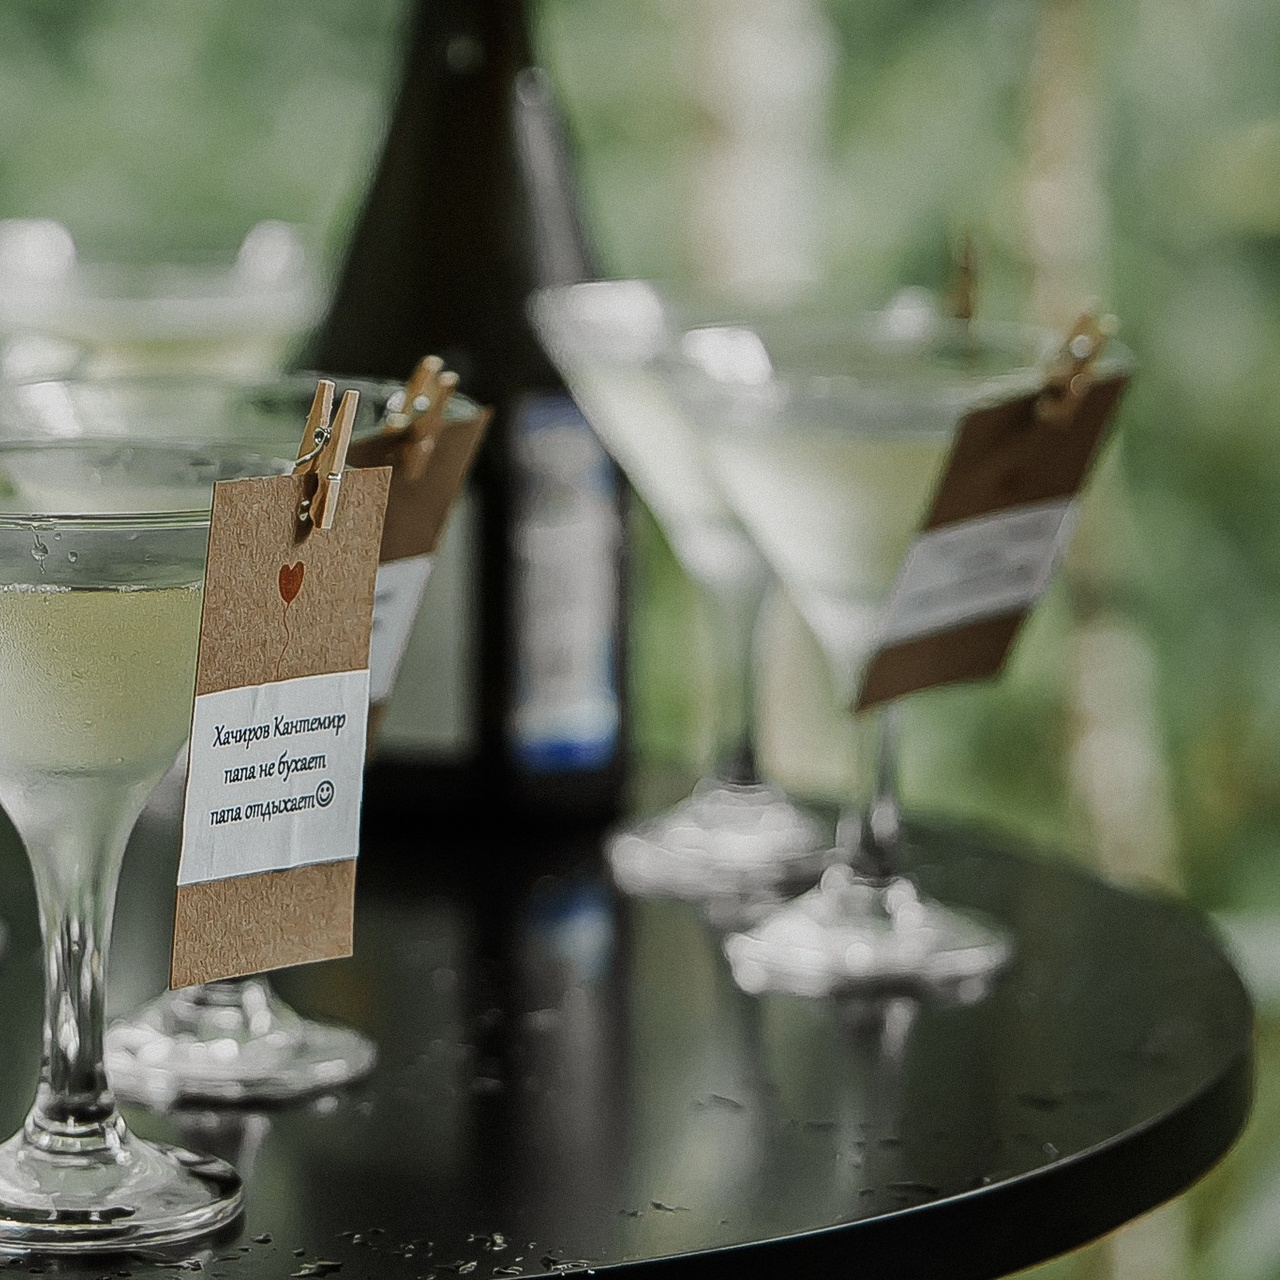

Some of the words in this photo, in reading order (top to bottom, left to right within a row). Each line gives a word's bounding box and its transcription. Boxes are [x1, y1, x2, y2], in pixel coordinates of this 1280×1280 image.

[212, 724, 271, 749] Хачиров
[273, 713, 346, 736] Кантемир
[224, 765, 257, 784] папа
[259, 761, 276, 779] не
[277, 750, 326, 782] бухает
[210, 807, 243, 826] папа
[244, 794, 315, 822] отдыхает
